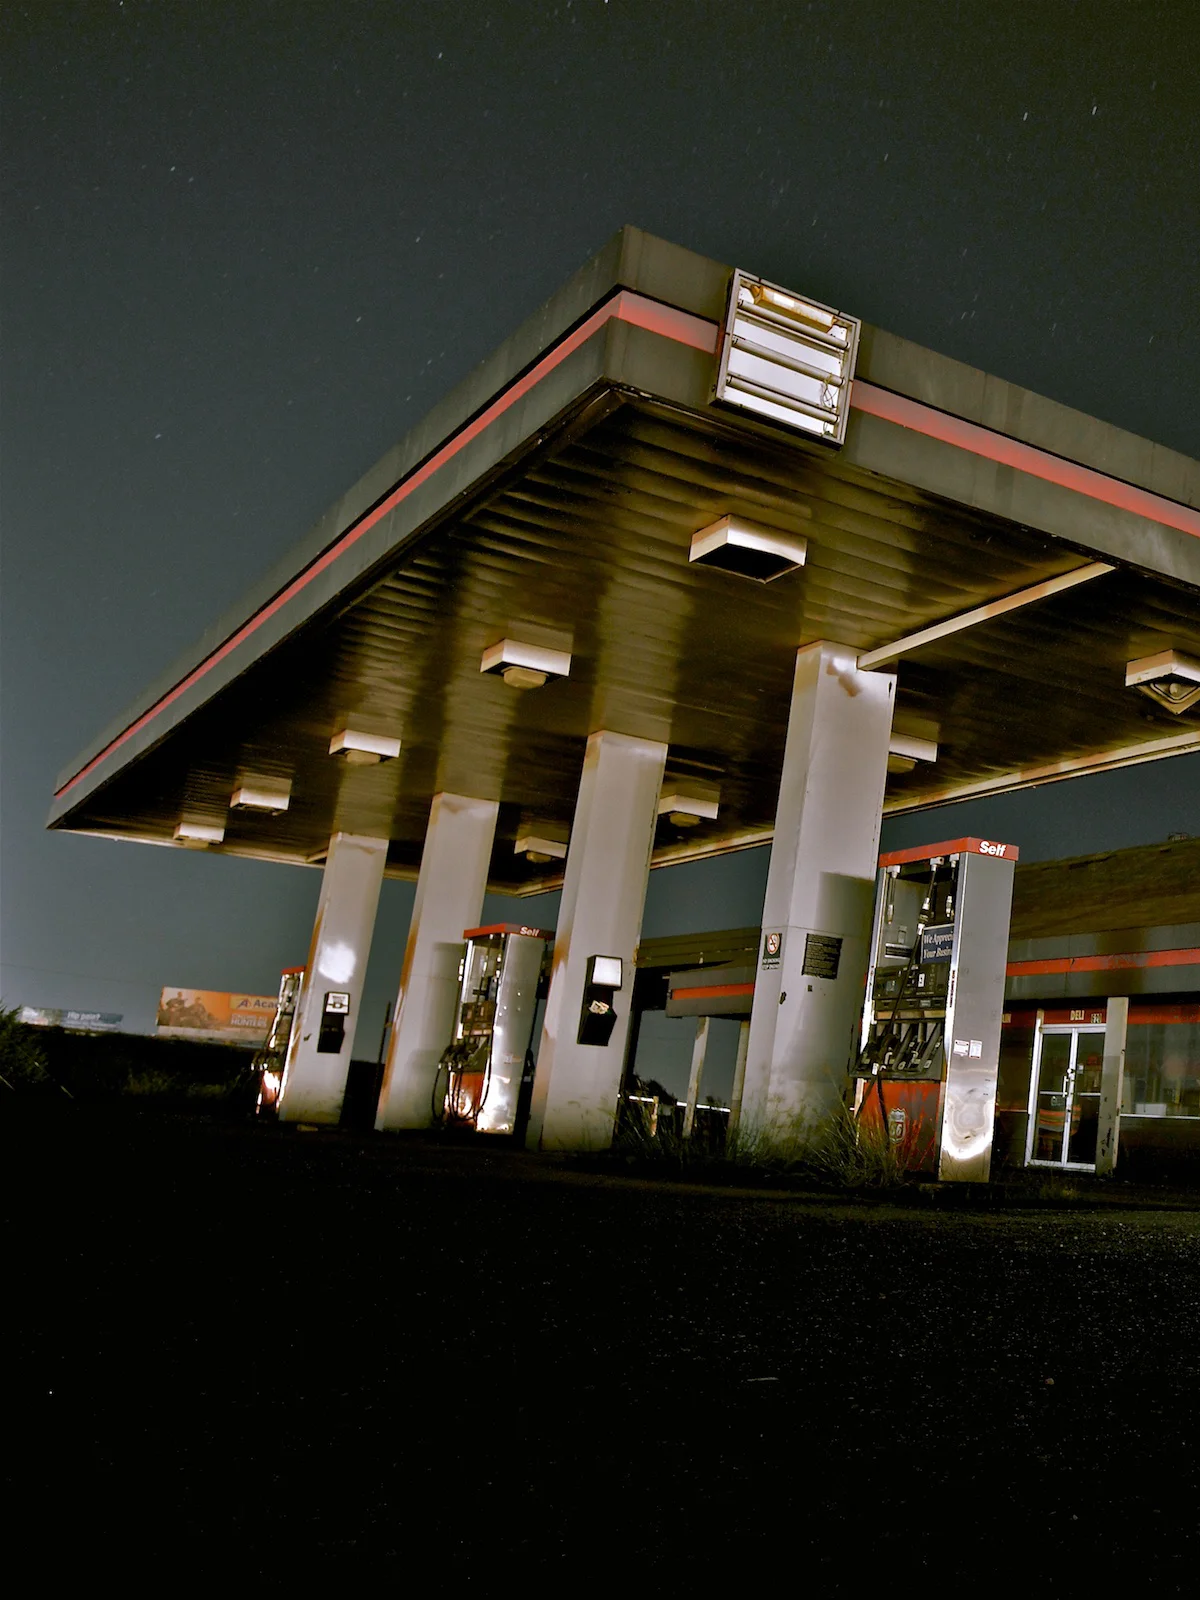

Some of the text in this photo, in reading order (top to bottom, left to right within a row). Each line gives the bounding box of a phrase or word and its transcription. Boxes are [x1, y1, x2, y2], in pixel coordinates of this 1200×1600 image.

[979, 840, 1007, 857] Self
[520, 926, 540, 937] Self
[1069, 1009, 1085, 1021] DELI
